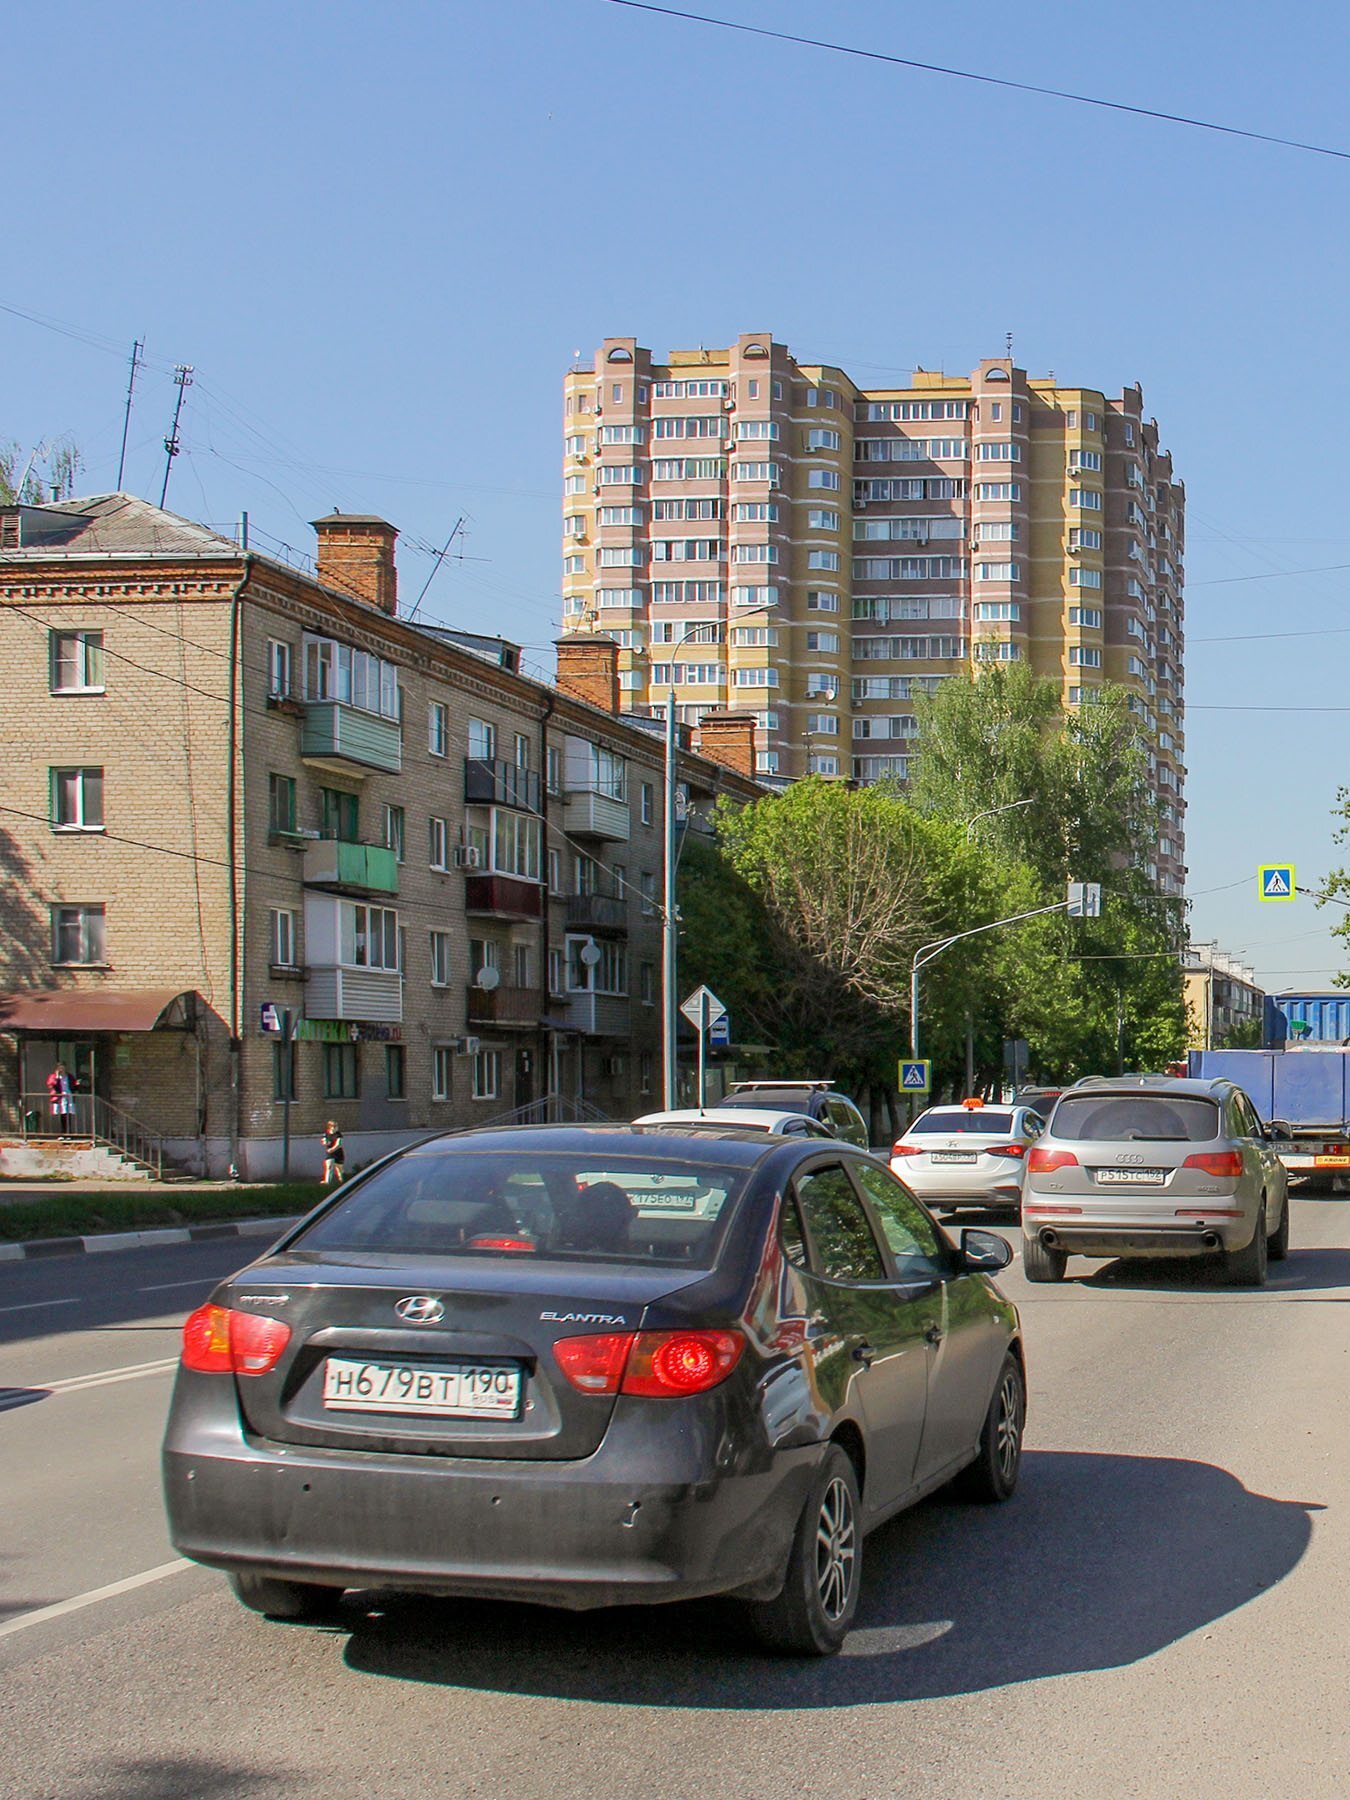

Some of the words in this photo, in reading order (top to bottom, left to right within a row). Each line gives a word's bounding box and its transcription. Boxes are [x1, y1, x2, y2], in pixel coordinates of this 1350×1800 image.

[299, 1020, 348, 1041] АПТЕКА
[1100, 1169, 1142, 1180] Р515ТС
[540, 1311, 627, 1326] ELANTRA
[336, 1366, 455, 1401] Н679ВТ
[465, 1369, 509, 1395] 190
